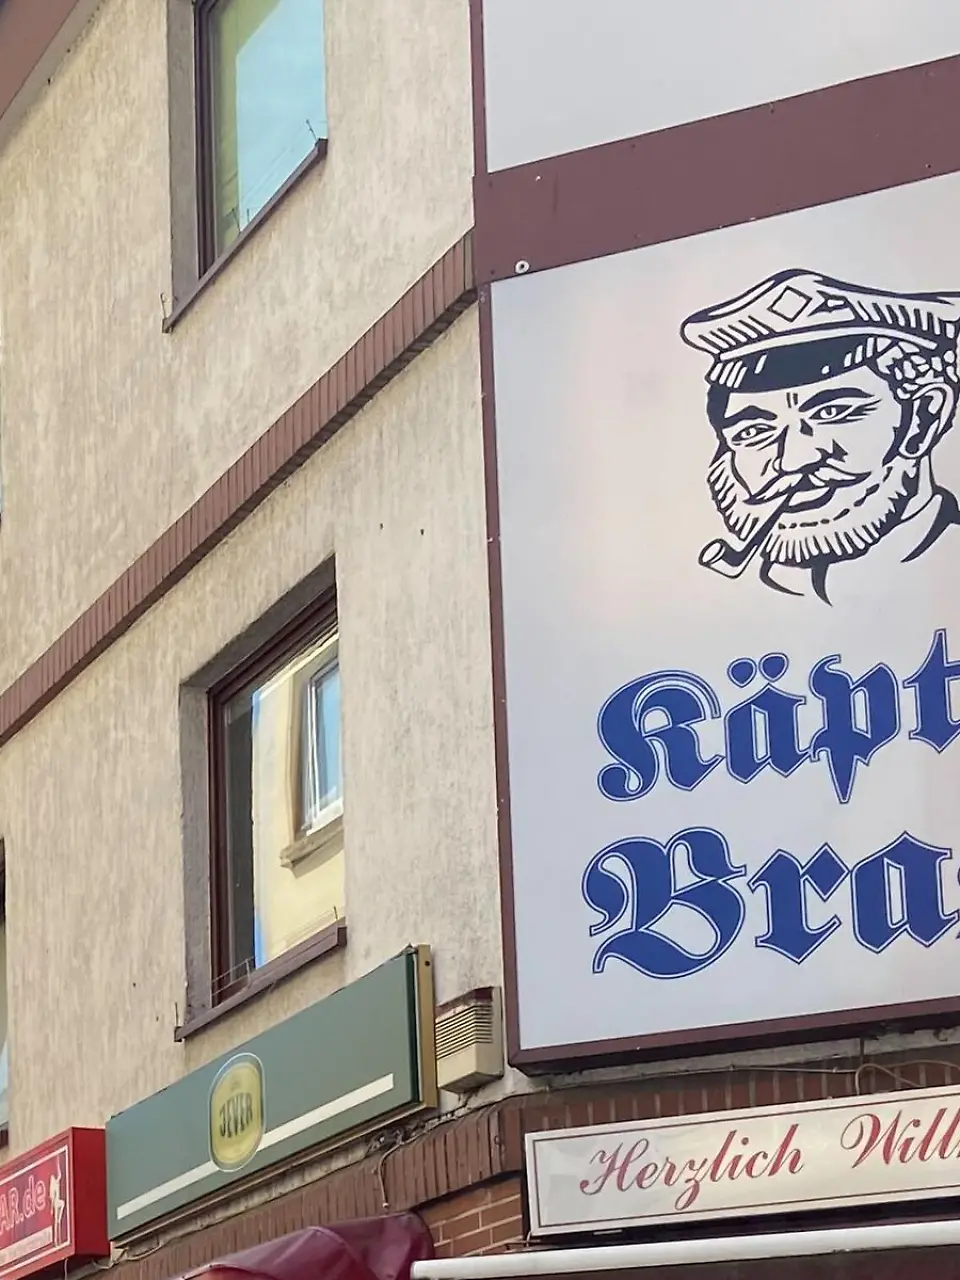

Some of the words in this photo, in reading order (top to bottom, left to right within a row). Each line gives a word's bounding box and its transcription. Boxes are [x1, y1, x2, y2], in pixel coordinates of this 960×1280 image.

[582, 826, 960, 979] Bra
[579, 1123, 804, 1211] Herzlich
[840, 1107, 960, 1169] Will
